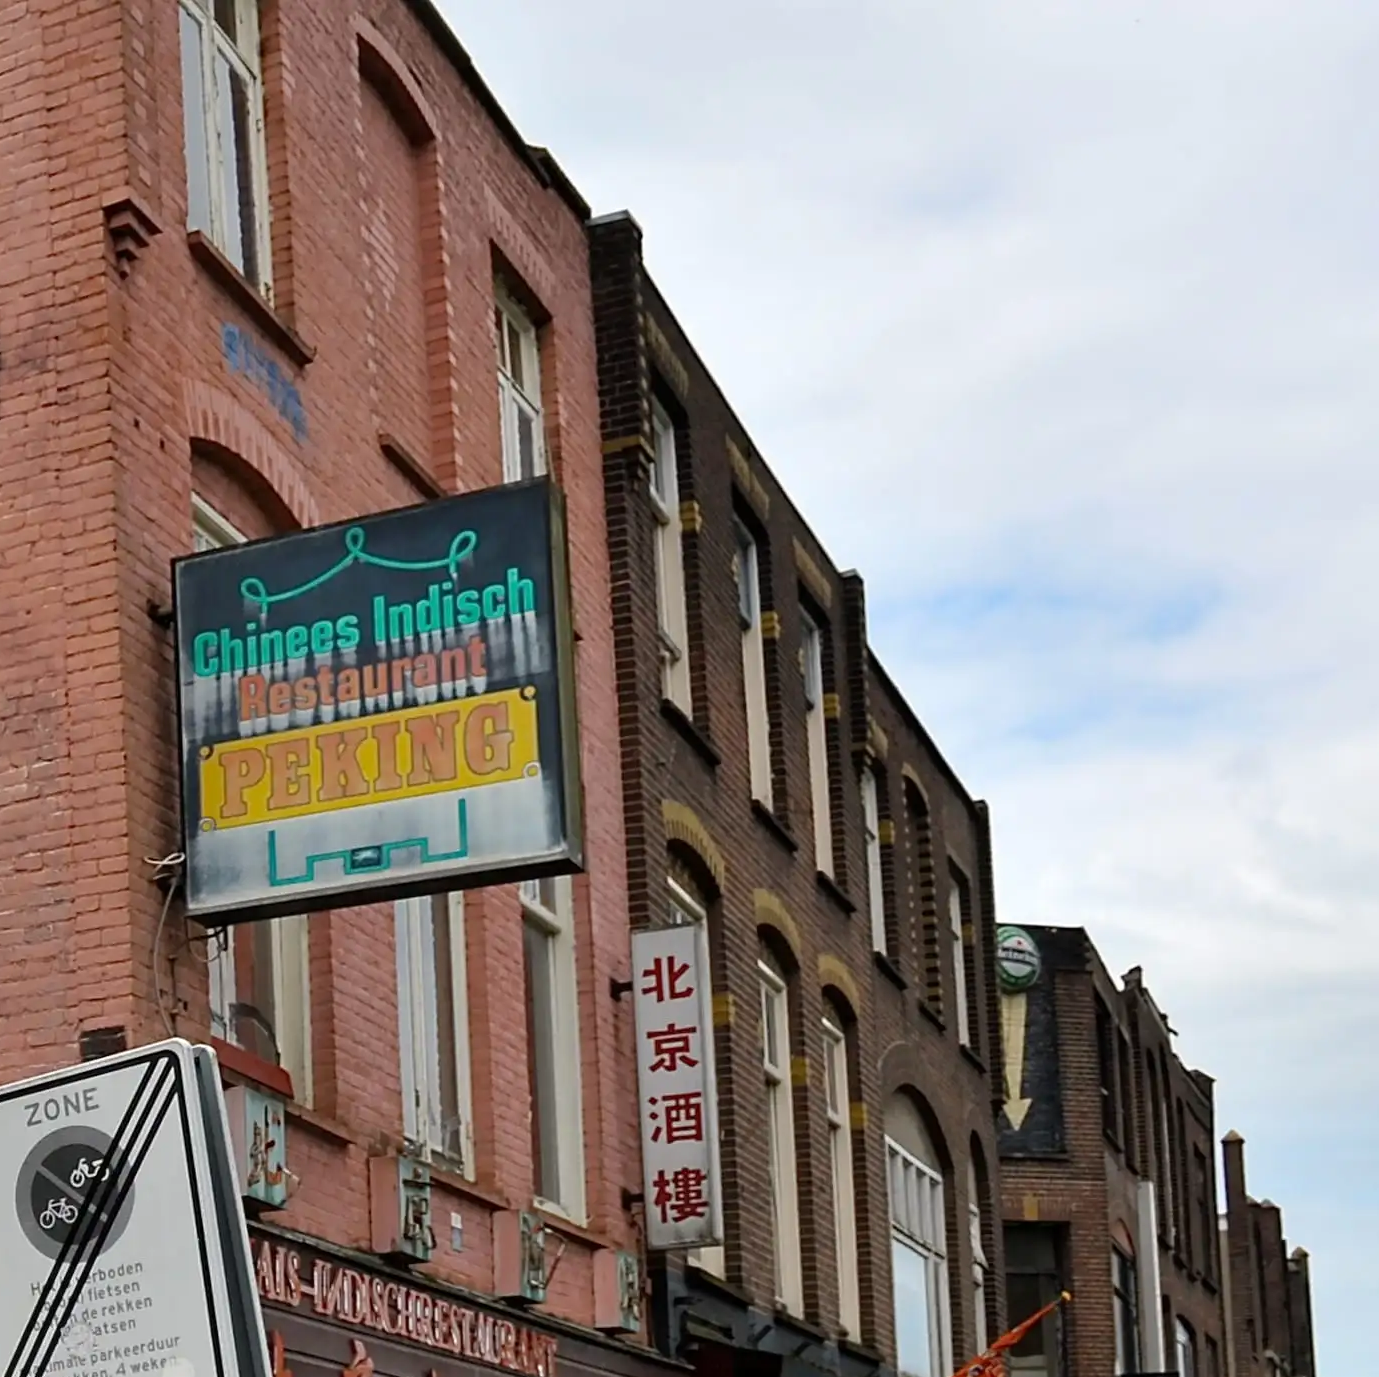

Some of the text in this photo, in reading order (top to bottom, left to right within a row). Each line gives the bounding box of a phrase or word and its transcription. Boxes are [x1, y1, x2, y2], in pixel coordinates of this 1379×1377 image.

[194, 567, 536, 678] Chinees Indisch
[239, 635, 487, 722] Restaurant
[219, 702, 516, 819] PEKING
[24, 1087, 101, 1128] ZONE
[641, 955, 710, 1225] 北京酒樓
[101, 1296, 153, 1317] rekken
[90, 1336, 181, 1367] parkeerduur
[115, 1362, 126, 1376] 4
